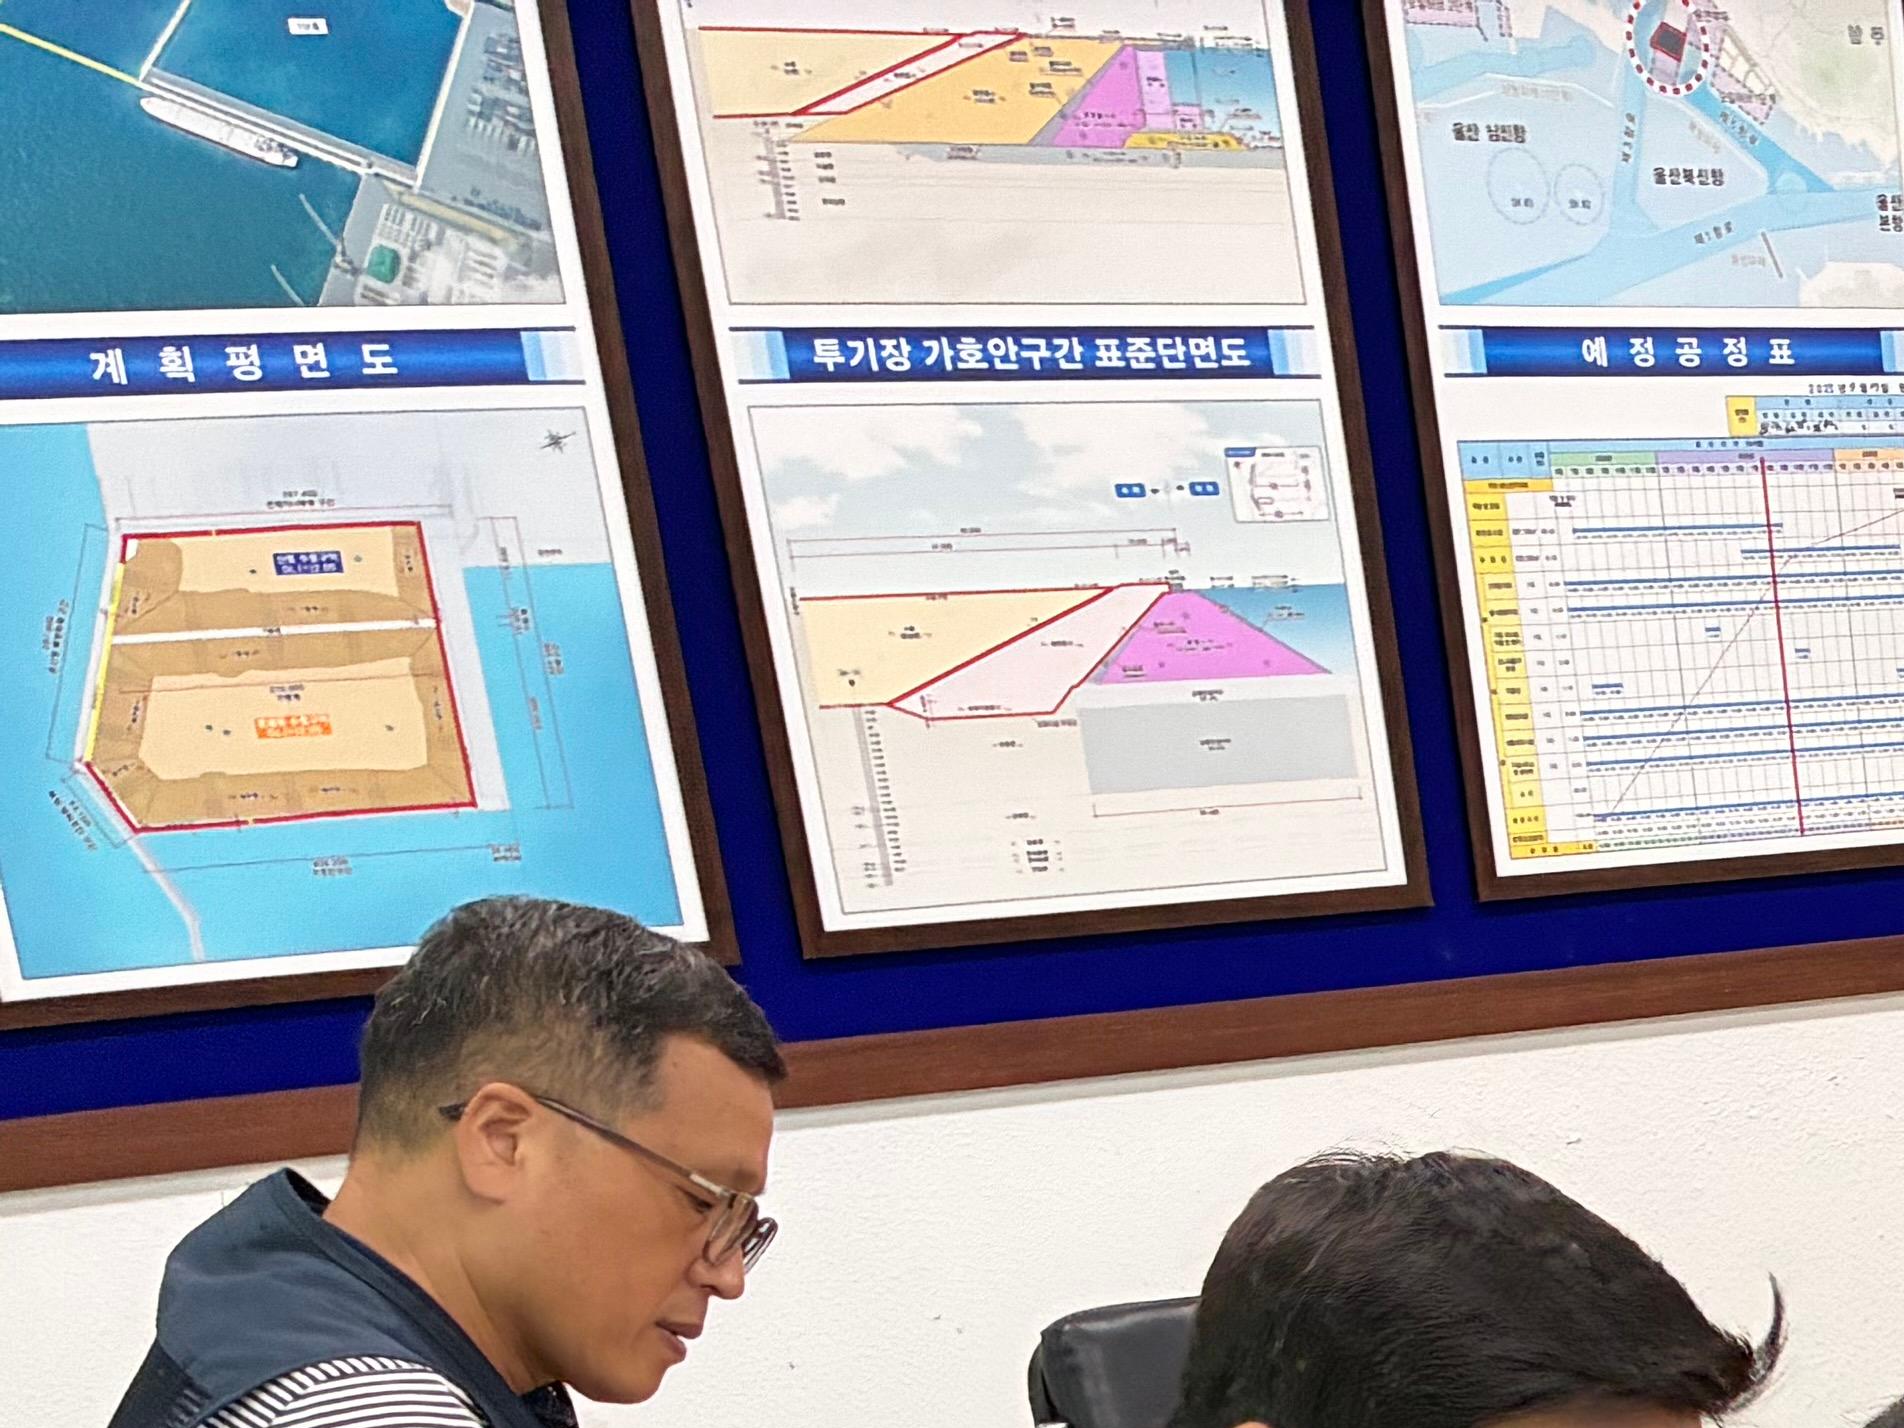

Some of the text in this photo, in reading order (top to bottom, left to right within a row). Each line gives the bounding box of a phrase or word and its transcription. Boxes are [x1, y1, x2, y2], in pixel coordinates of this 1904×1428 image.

[1452, 122, 1480, 142] 울산
[1653, 167, 1725, 187] 울산북신항
[812, 336, 1251, 372] 투기장 가호안구간 표준단면도
